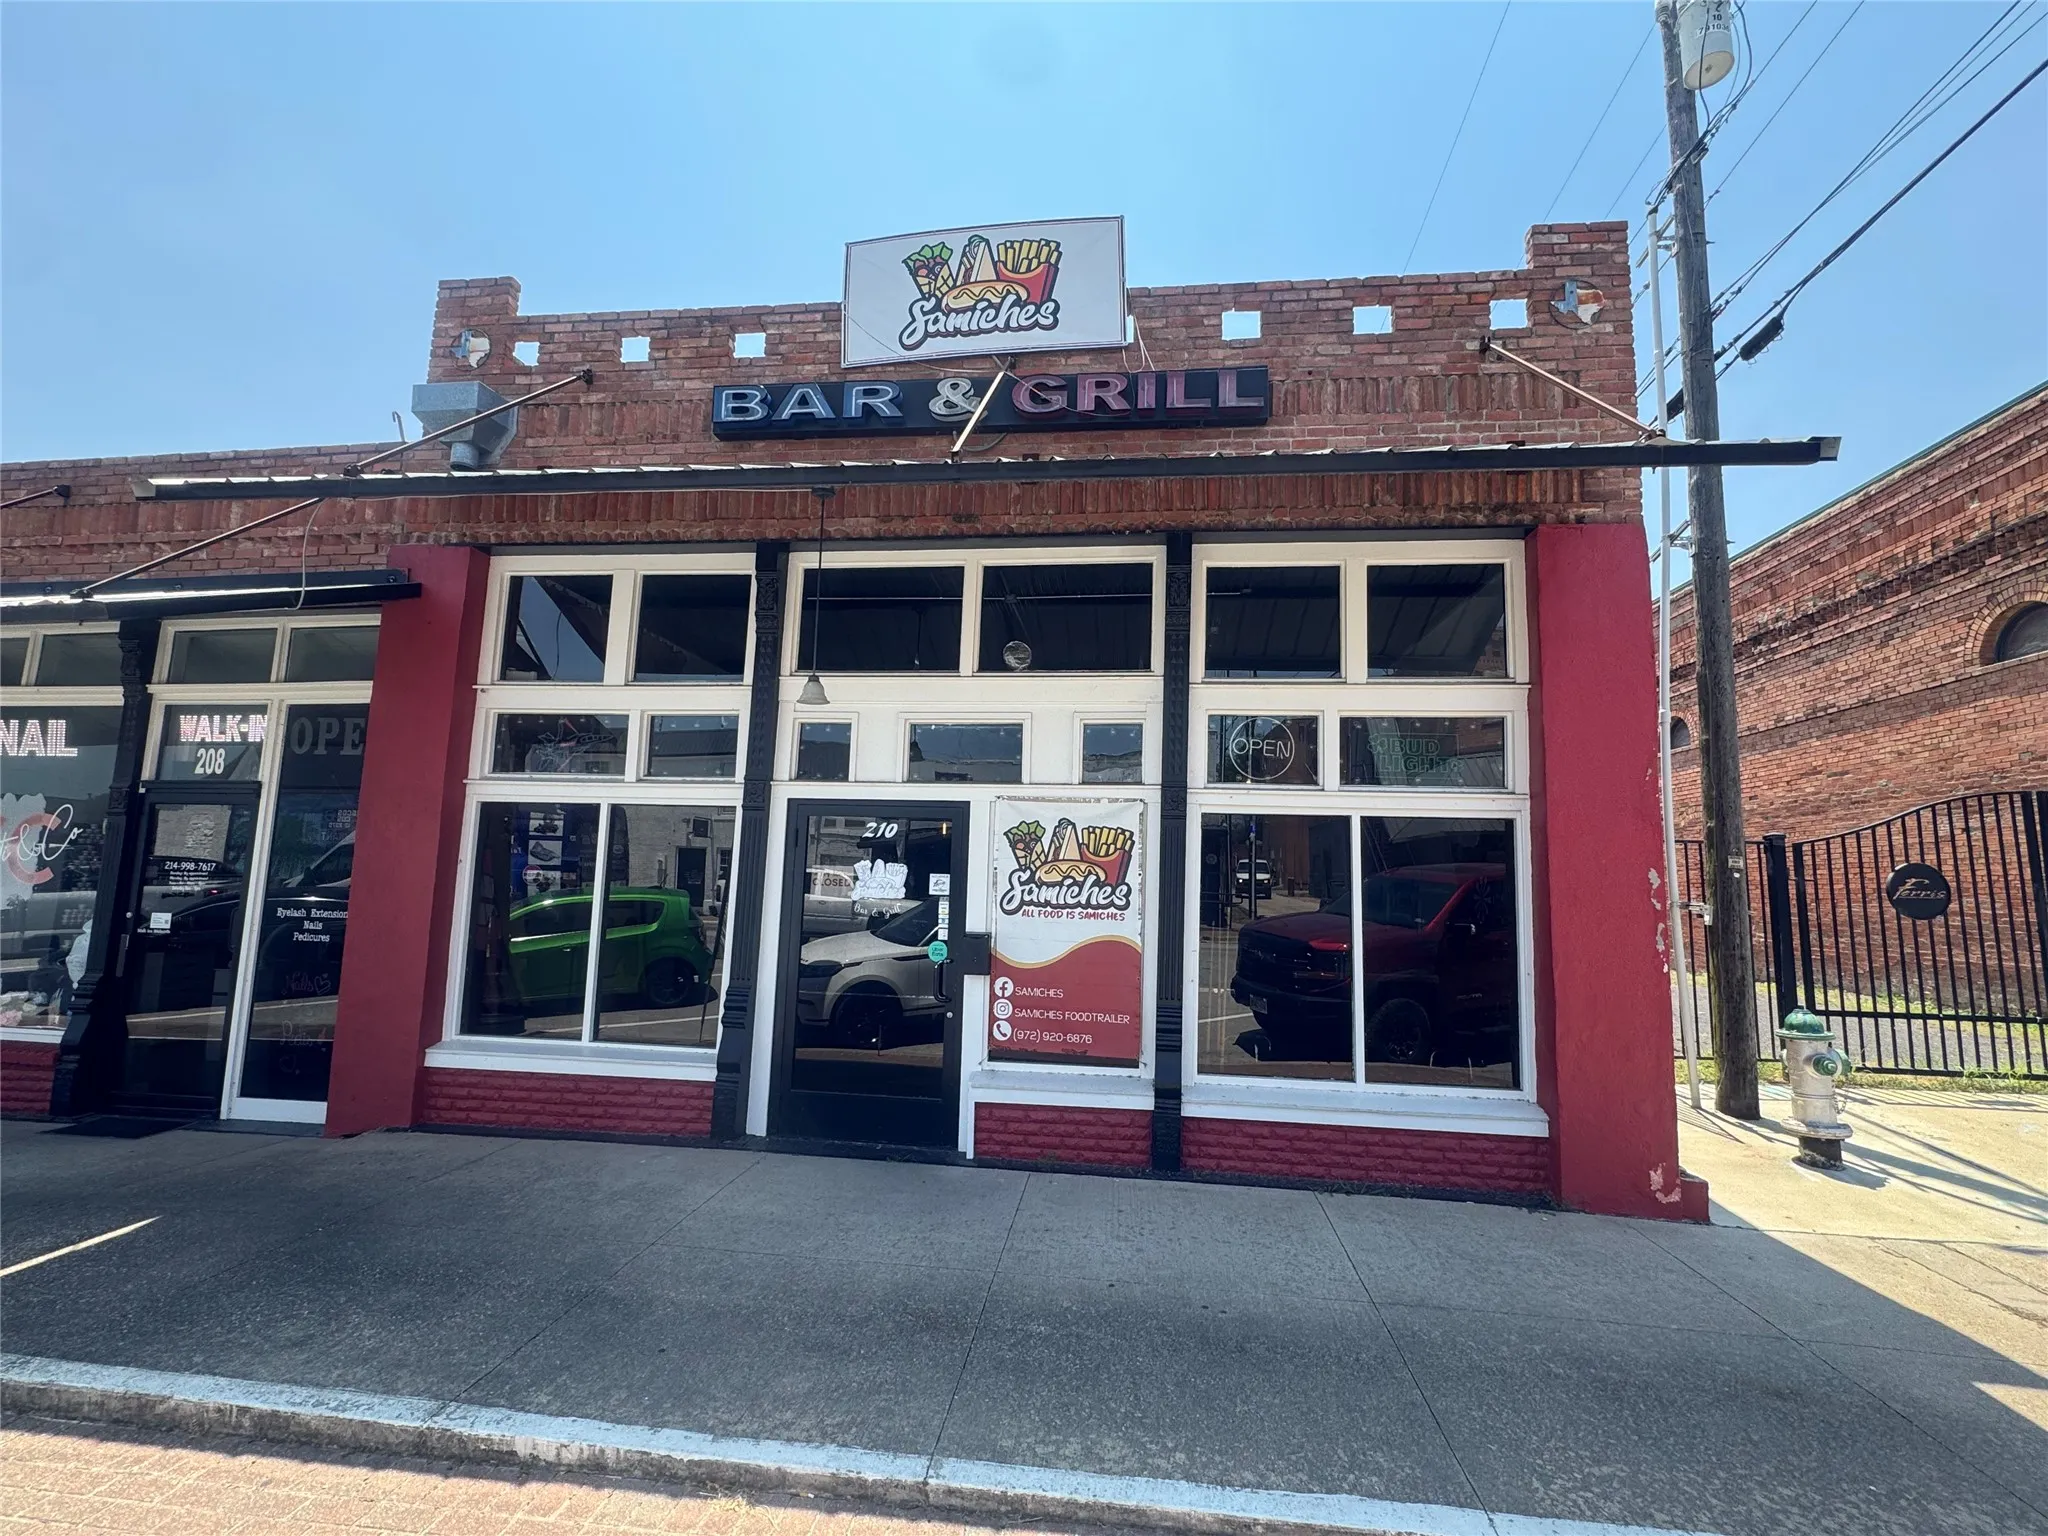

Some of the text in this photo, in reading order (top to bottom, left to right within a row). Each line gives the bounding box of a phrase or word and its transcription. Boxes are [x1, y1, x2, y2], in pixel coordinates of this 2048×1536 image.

[901, 293, 1057, 346] Samiches
[713, 368, 1265, 424] BAR & GRILL
[179, 714, 267, 742] WALK-IN
[0, 719, 78, 757] NAIL
[1390, 737, 1441, 756] BUD
[1232, 737, 1292, 760] OPEN
[194, 748, 226, 775] 208
[1378, 755, 1453, 773] LIGHT
[862, 821, 899, 839] 210
[164, 861, 216, 871] 214-998-7617
[1002, 867, 1127, 911] Samiches
[276, 907, 348, 919] Eyelash Extension
[853, 902, 868, 915] Bar
[1021, 908, 1126, 922] ALL FOOD IS SAMICHES
[303, 920, 323, 930] Nails
[292, 932, 331, 943] Pedicures
[1014, 986, 1064, 998] SAMICHES
[1014, 1008, 1130, 1024] SAMICHES FOODTRAILER
[1013, 1028, 1093, 1044] (972) 920-6876
